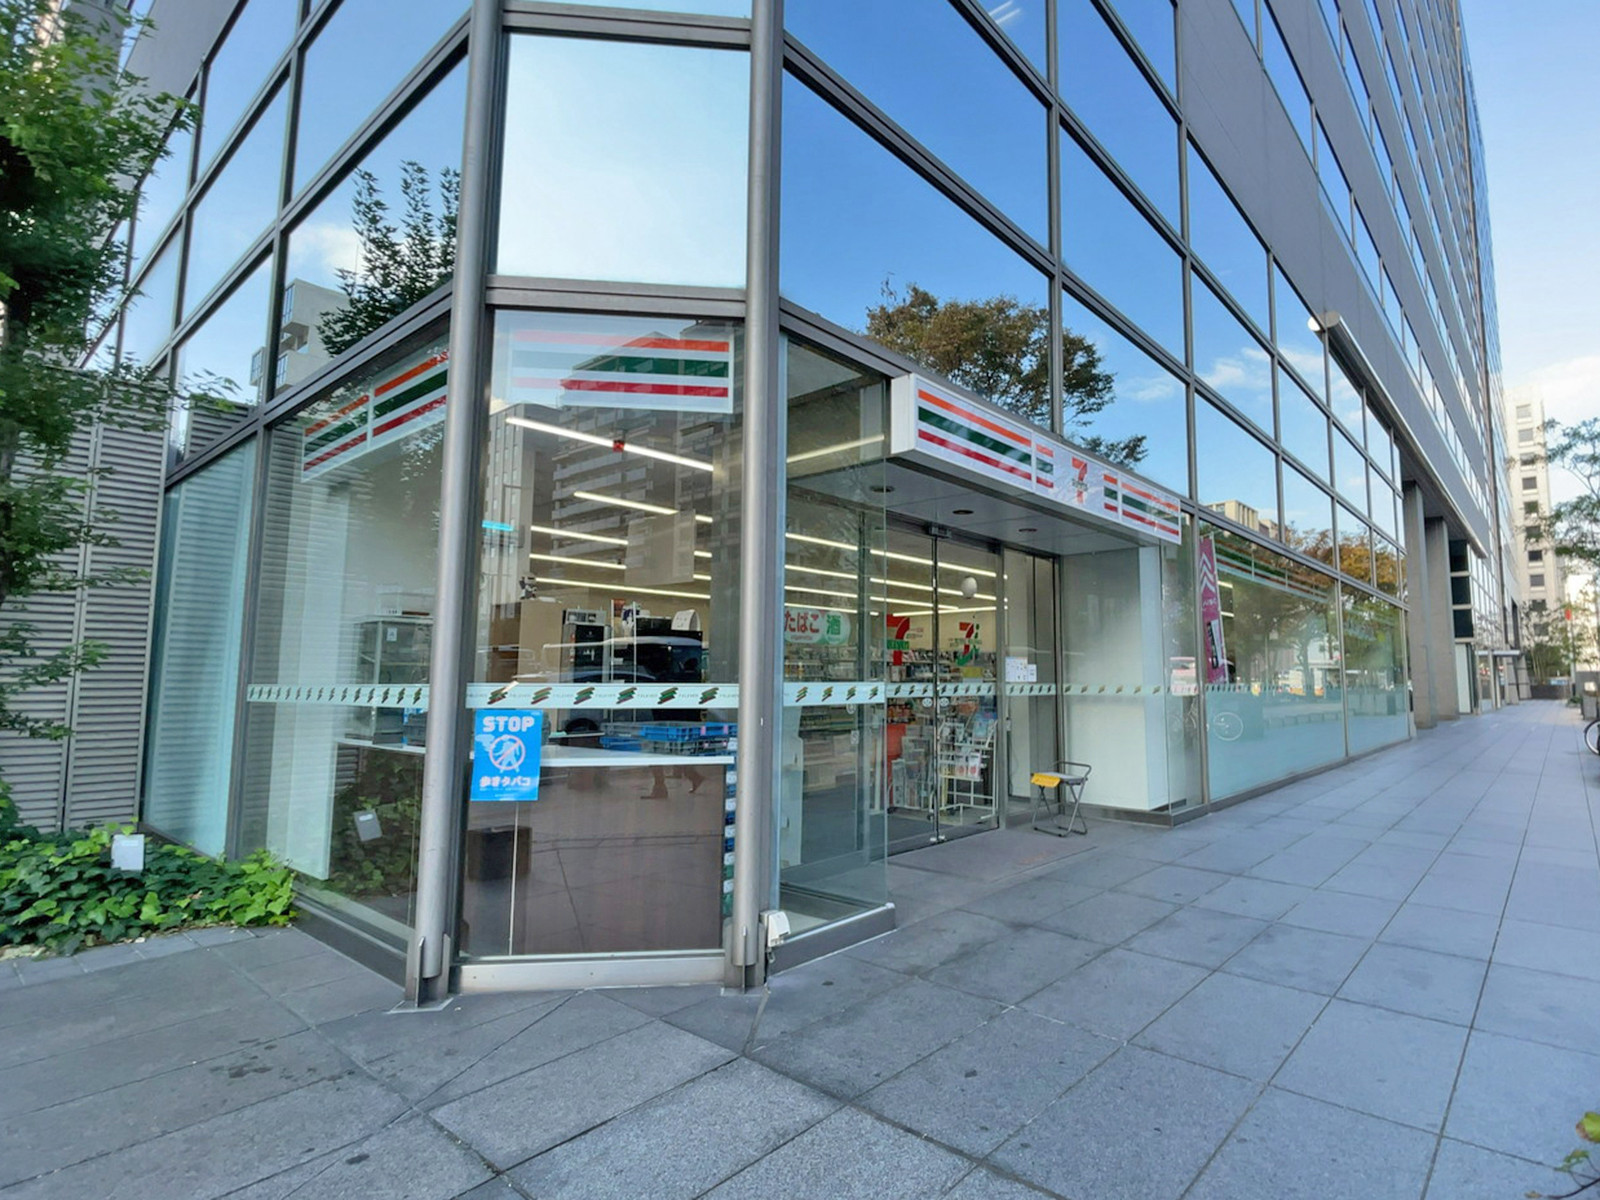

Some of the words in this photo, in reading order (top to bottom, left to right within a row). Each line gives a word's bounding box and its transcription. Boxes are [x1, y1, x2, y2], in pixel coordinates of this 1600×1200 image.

[784, 610, 820, 633] たばこ
[826, 614, 842, 635] 酒
[482, 716, 535, 732] STOP
[480, 776, 531, 788] 歩きタバコ
